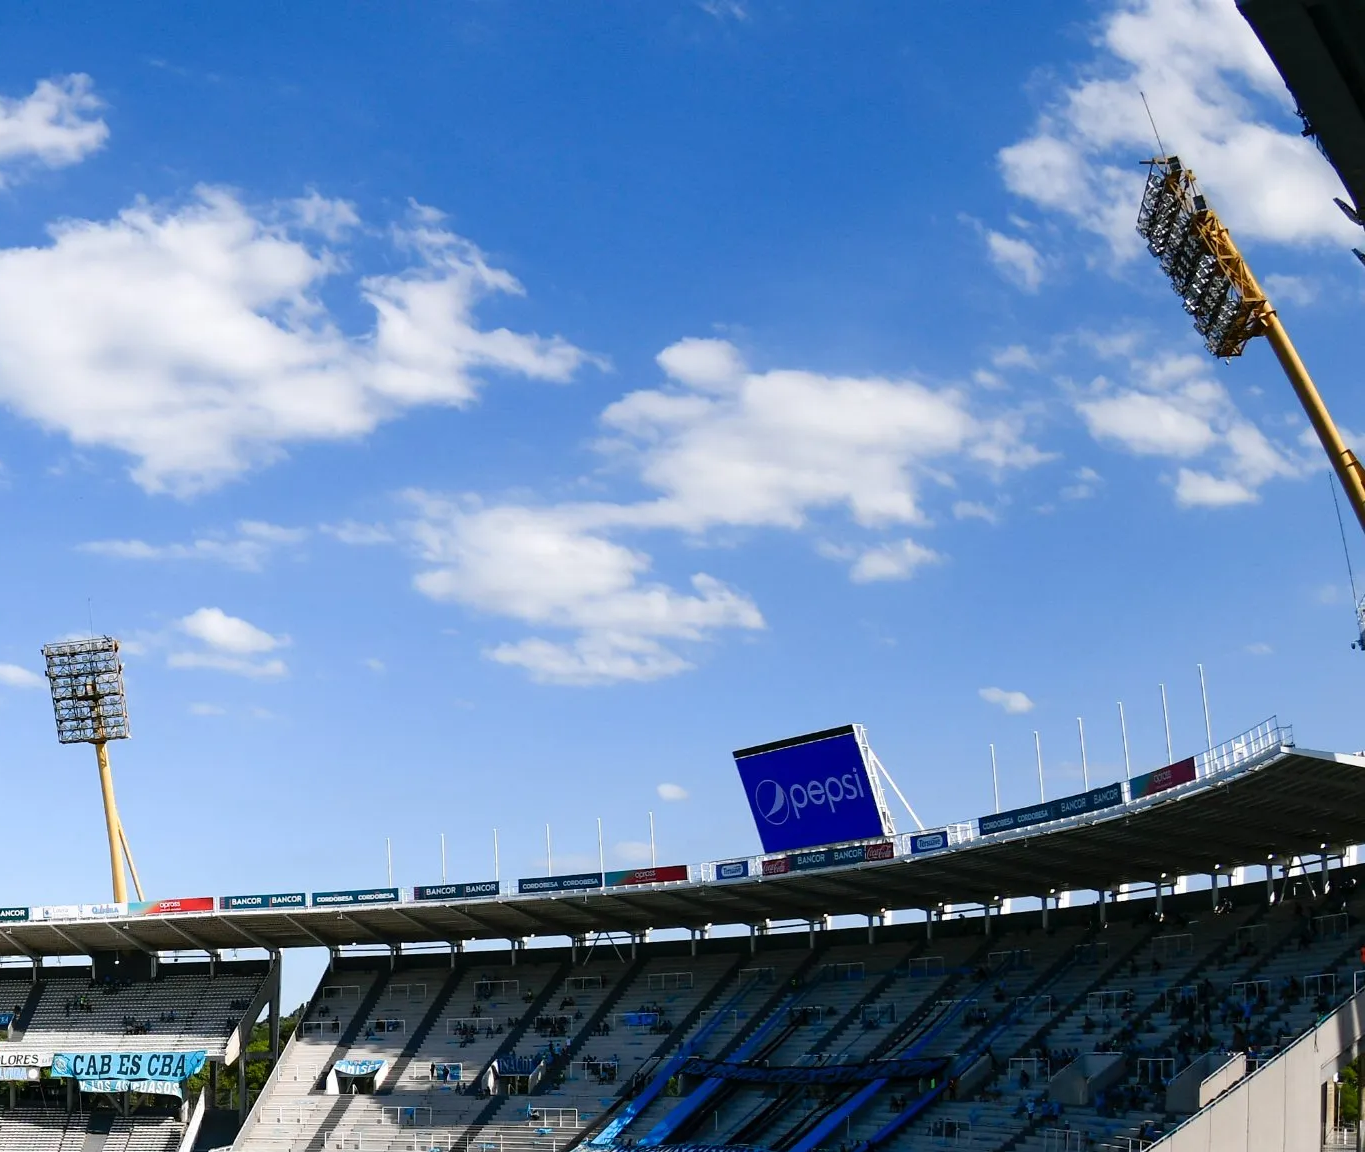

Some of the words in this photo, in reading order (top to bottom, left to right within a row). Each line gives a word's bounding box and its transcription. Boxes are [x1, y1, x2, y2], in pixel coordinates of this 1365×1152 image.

[789, 767, 865, 820] pepsi
[797, 853, 826, 865] BANCOR
[833, 848, 863, 861] BANCOR
[426, 886, 457, 896] BANCOR
[465, 883, 497, 893] BANCOR
[231, 896, 262, 906] BANCOR
[271, 895, 303, 905] BANCOR
[73, 1054, 112, 1076] CAB
[117, 1054, 143, 1076] ES
[147, 1053, 186, 1077] CBA
